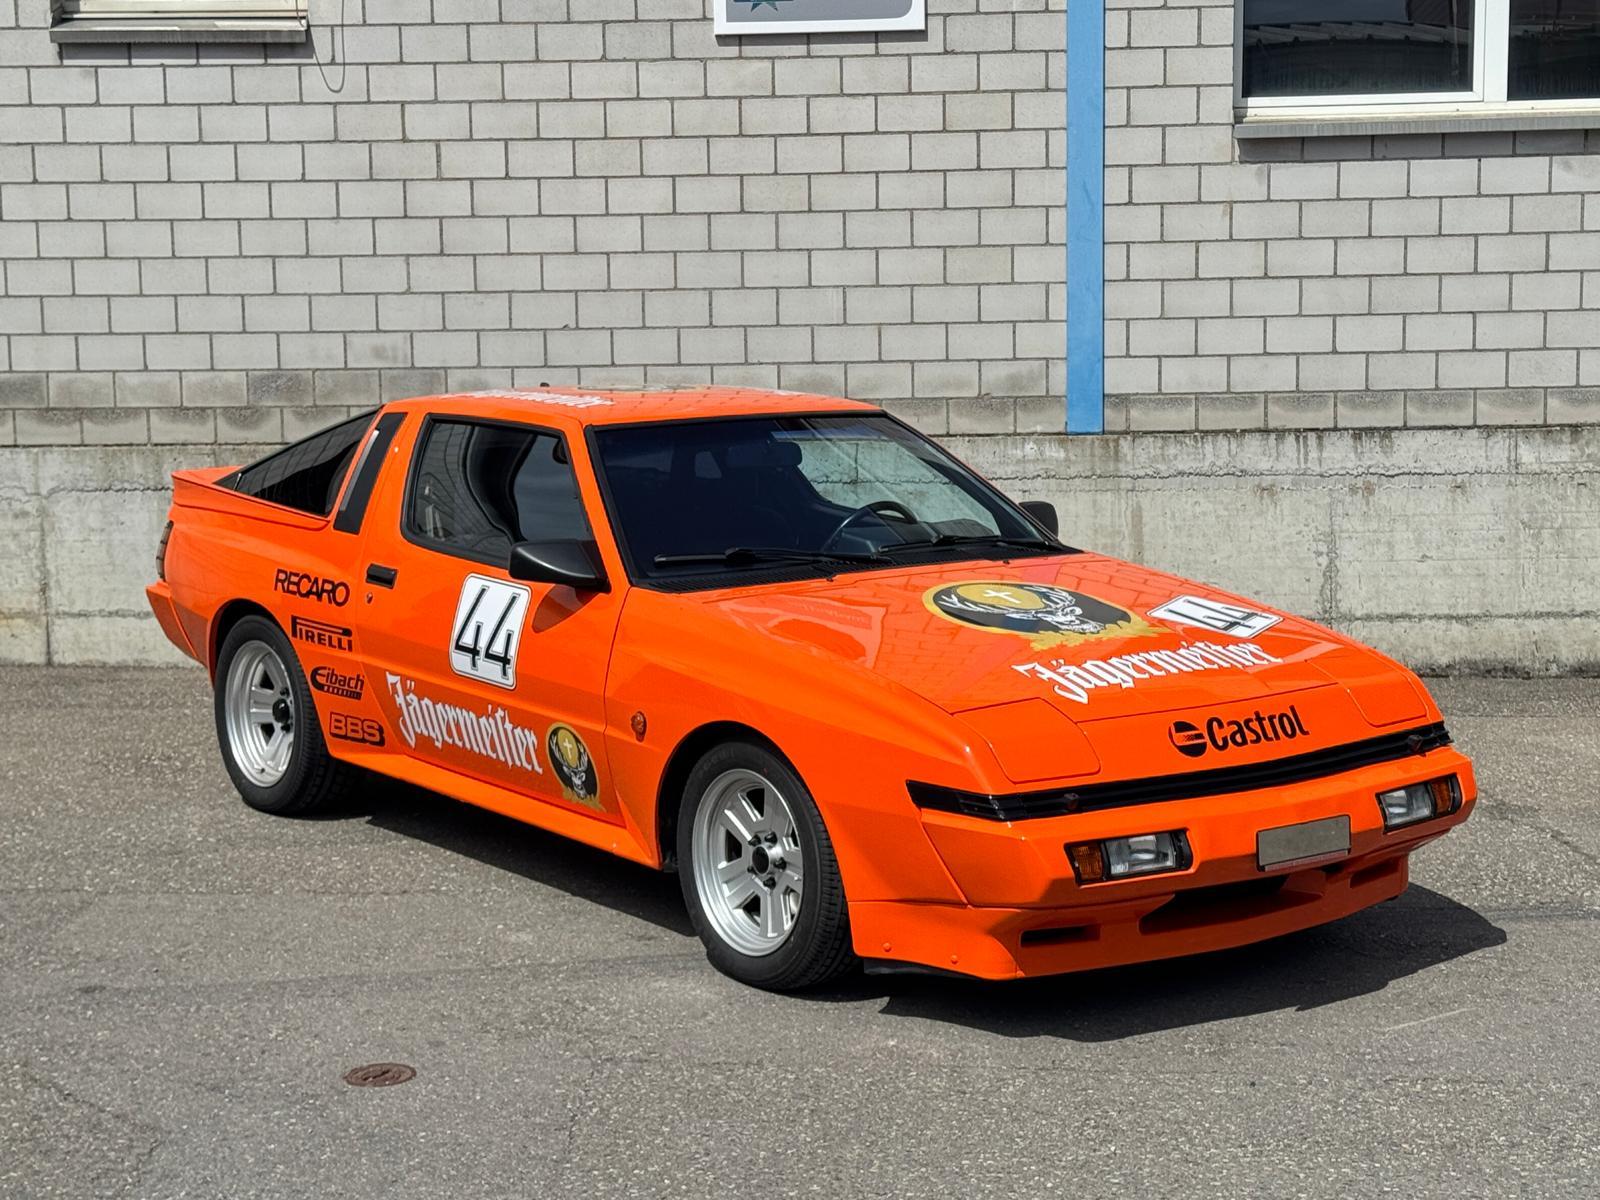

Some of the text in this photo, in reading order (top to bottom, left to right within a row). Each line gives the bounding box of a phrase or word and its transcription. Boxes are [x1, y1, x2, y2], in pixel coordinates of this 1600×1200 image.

[274, 568, 350, 607] RECARO
[291, 615, 353, 652] PIRELLI
[452, 585, 521, 680] 44
[1163, 599, 1273, 632] 44
[310, 665, 365, 693] Eibach
[330, 711, 386, 747] BBS
[1206, 704, 1309, 752] Castrol
